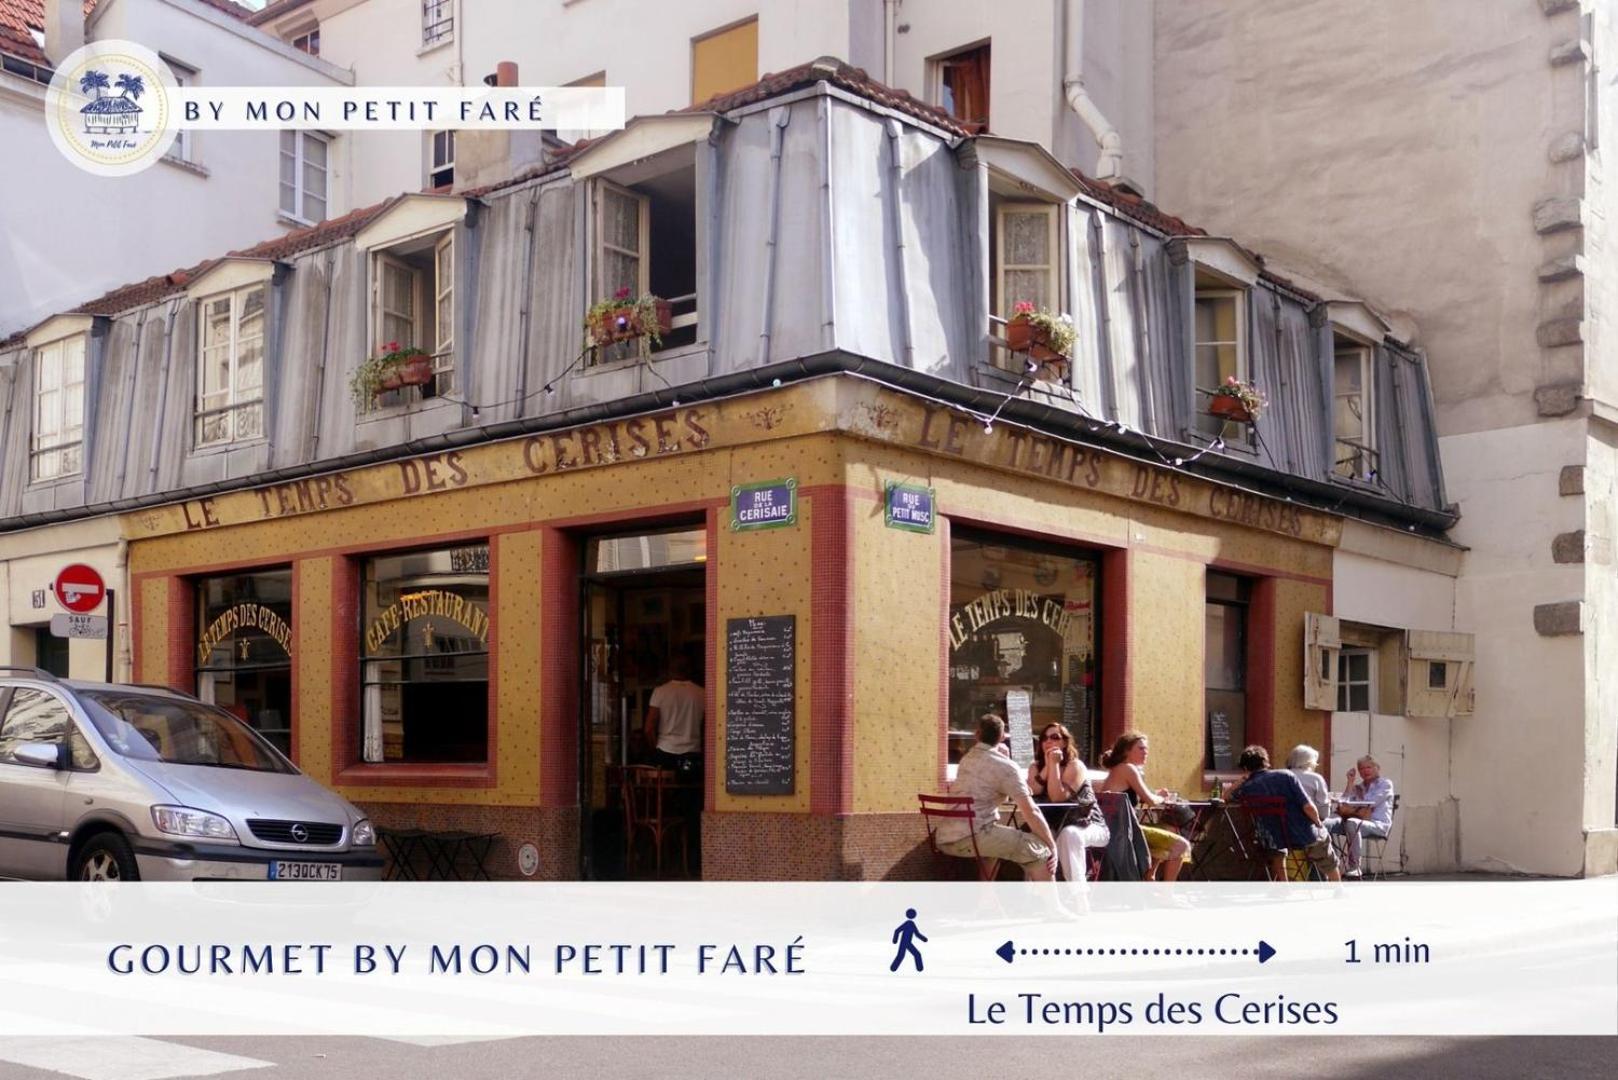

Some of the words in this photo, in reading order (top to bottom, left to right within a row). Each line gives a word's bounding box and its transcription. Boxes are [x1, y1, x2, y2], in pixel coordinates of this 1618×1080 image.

[181, 499, 221, 530] LE
[255, 473, 354, 518] TEMPS
[398, 452, 469, 495] DES
[523, 408, 711, 474] CERISES
[917, 404, 968, 457] LE
[1008, 429, 1101, 488] TEMPS
[1131, 465, 1182, 507] DES
[1210, 486, 1302, 538] CERISES
[754, 490, 773, 503] RUE
[903, 492, 920, 506] RUE
[739, 504, 788, 521] CERISAIE
[892, 506, 910, 520] PETIT
[68, 615, 92, 624] SAUF
[949, 612, 969, 651] LE
[964, 589, 1011, 632] TEMPS
[1015, 588, 1040, 620] DES
[198, 632, 212, 664] LE
[209, 606, 239, 647] TEMPS
[239, 603, 258, 627] DES
